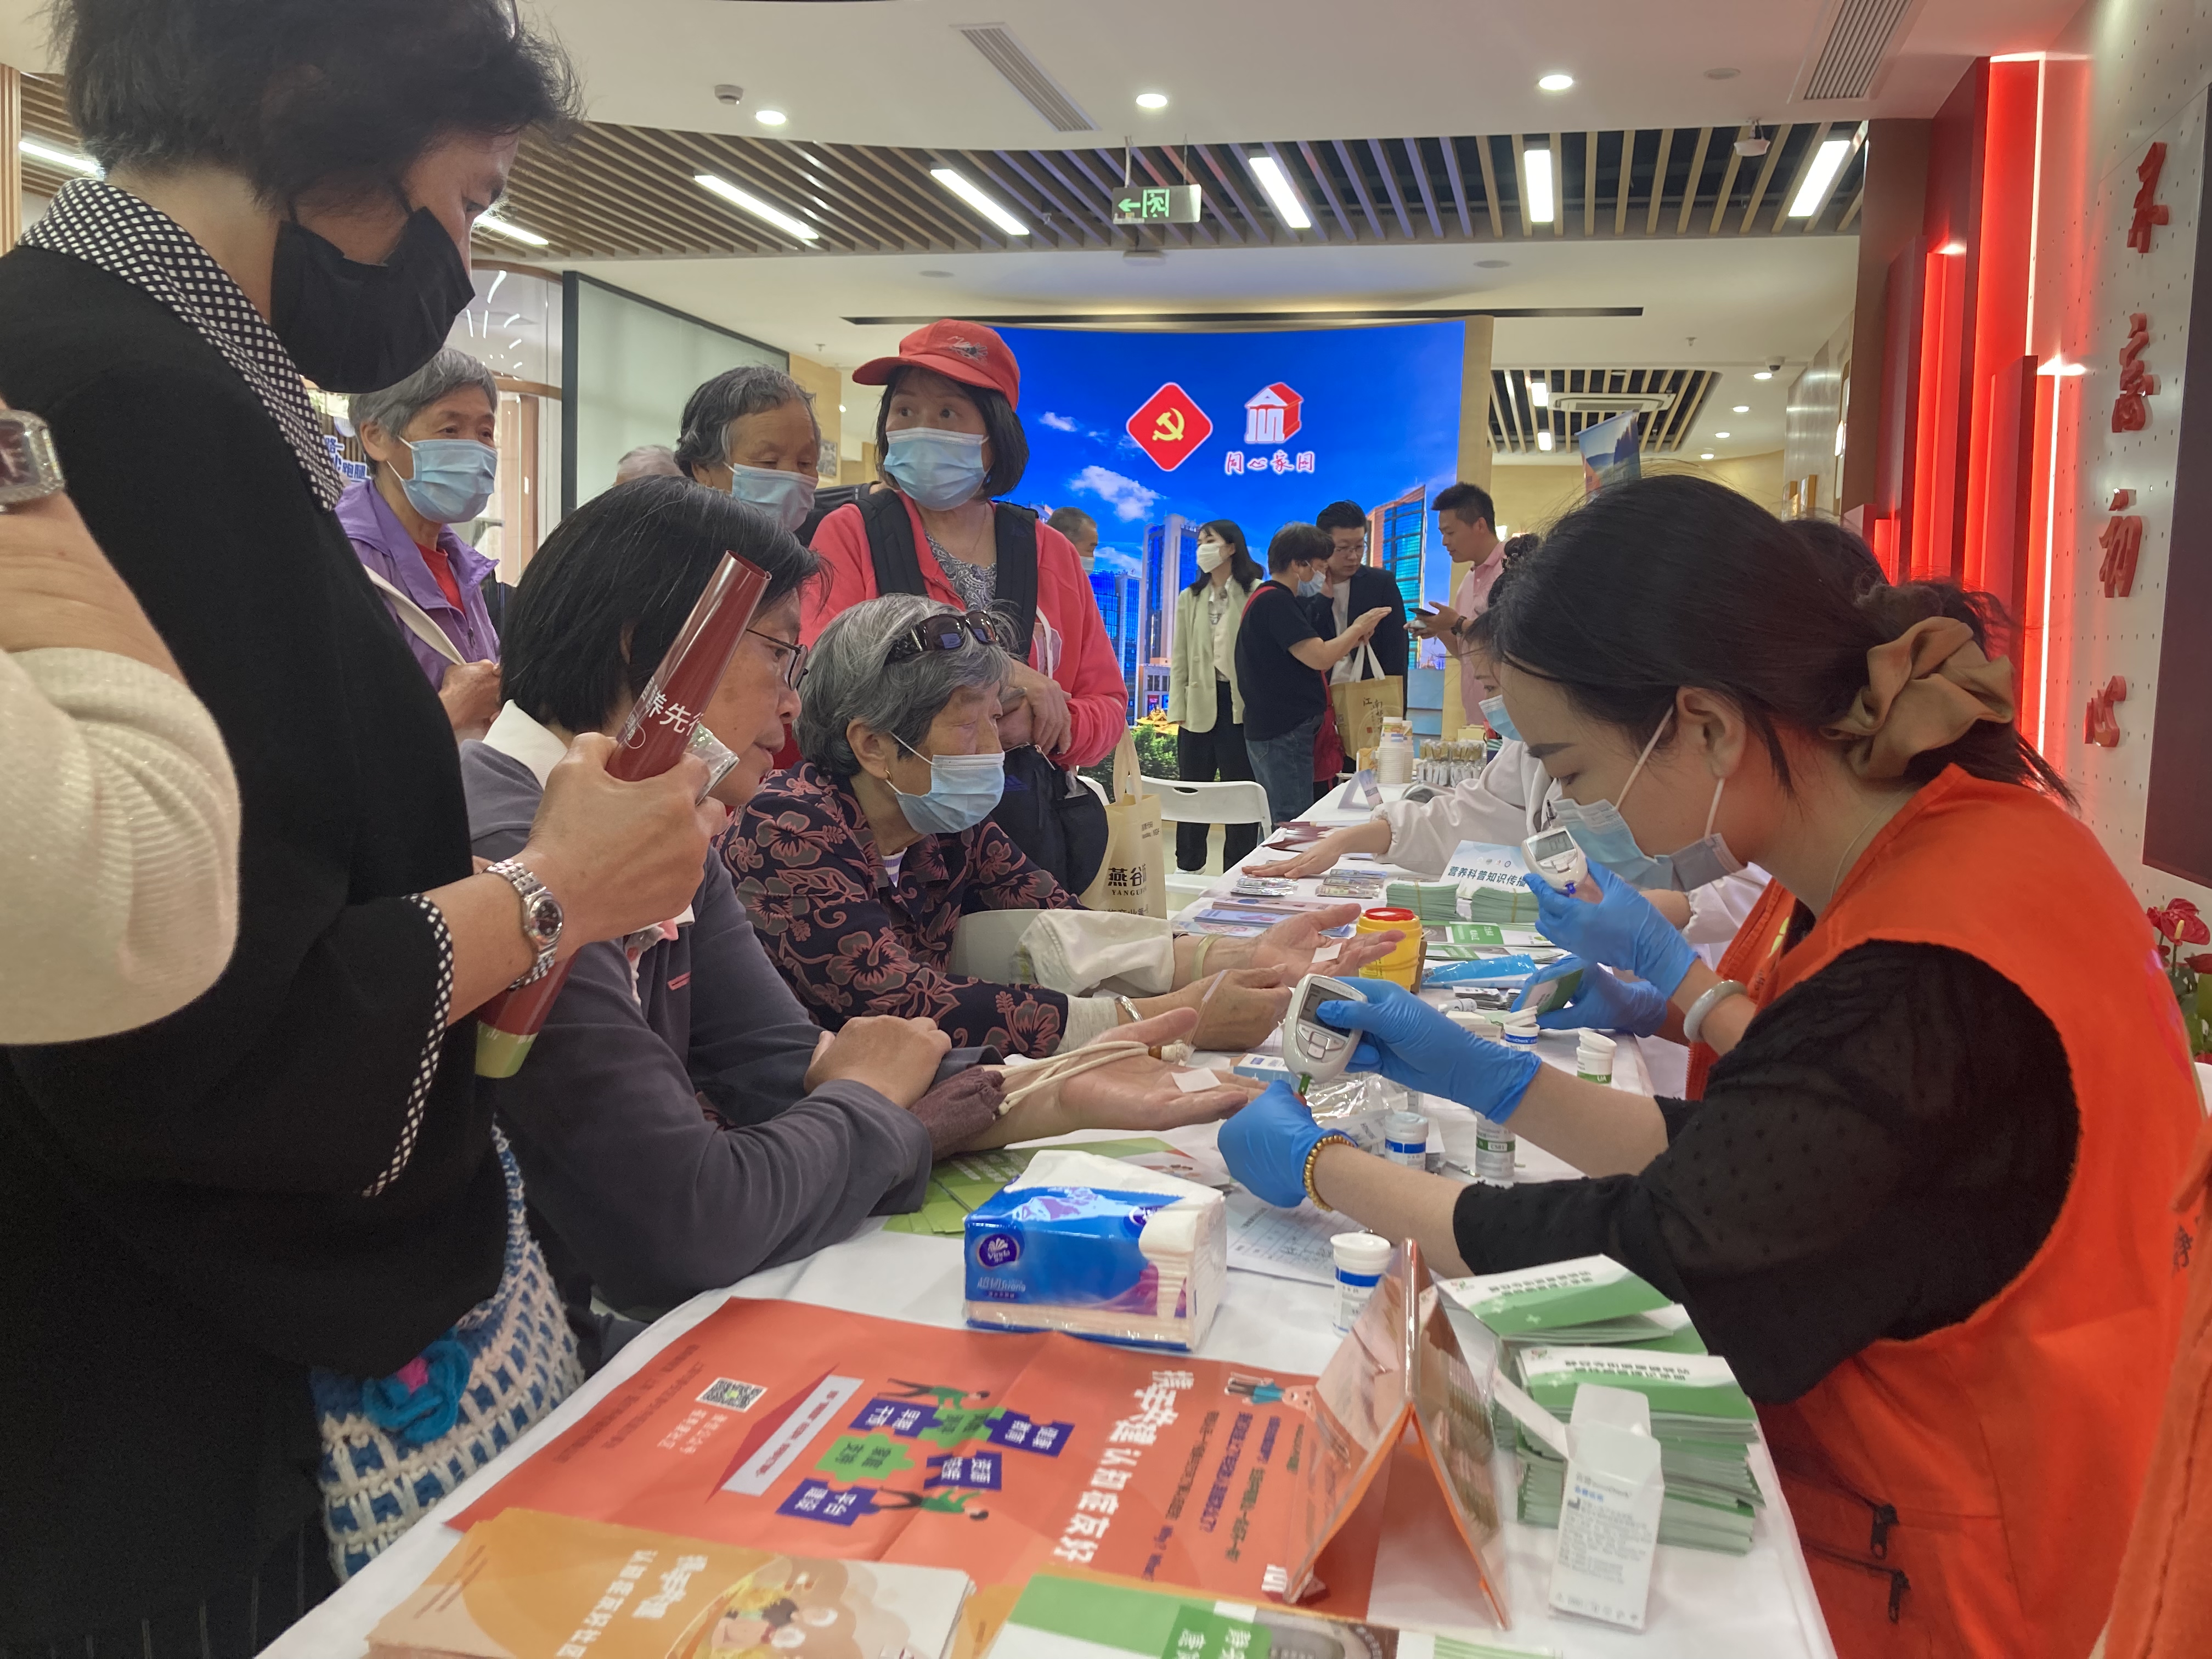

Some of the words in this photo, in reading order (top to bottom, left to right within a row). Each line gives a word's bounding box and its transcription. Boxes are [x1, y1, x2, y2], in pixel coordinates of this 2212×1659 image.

[1225, 450, 1314, 475] 同心家园
[987, 1249, 1011, 1260] Vinda
[794, 1486, 828, 1512] 建设
[823, 1491, 857, 1517] 平台
